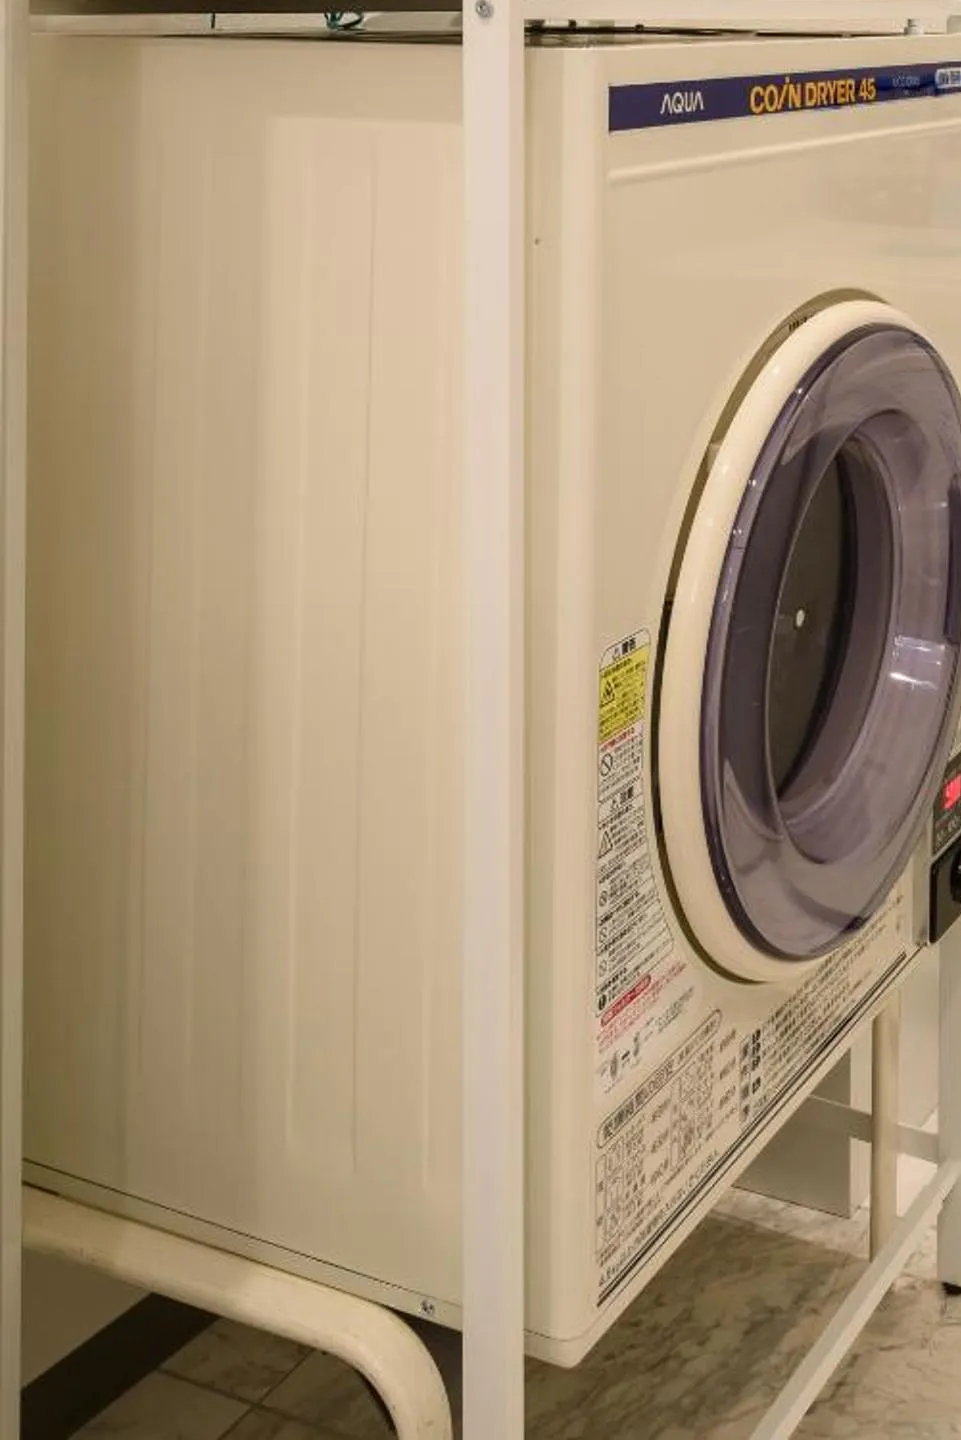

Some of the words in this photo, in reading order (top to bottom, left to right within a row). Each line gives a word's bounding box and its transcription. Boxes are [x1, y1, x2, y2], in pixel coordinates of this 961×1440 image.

[660, 90, 704, 114] AQUA
[804, 79, 855, 108] DRYER
[858, 77, 876, 101] 45
